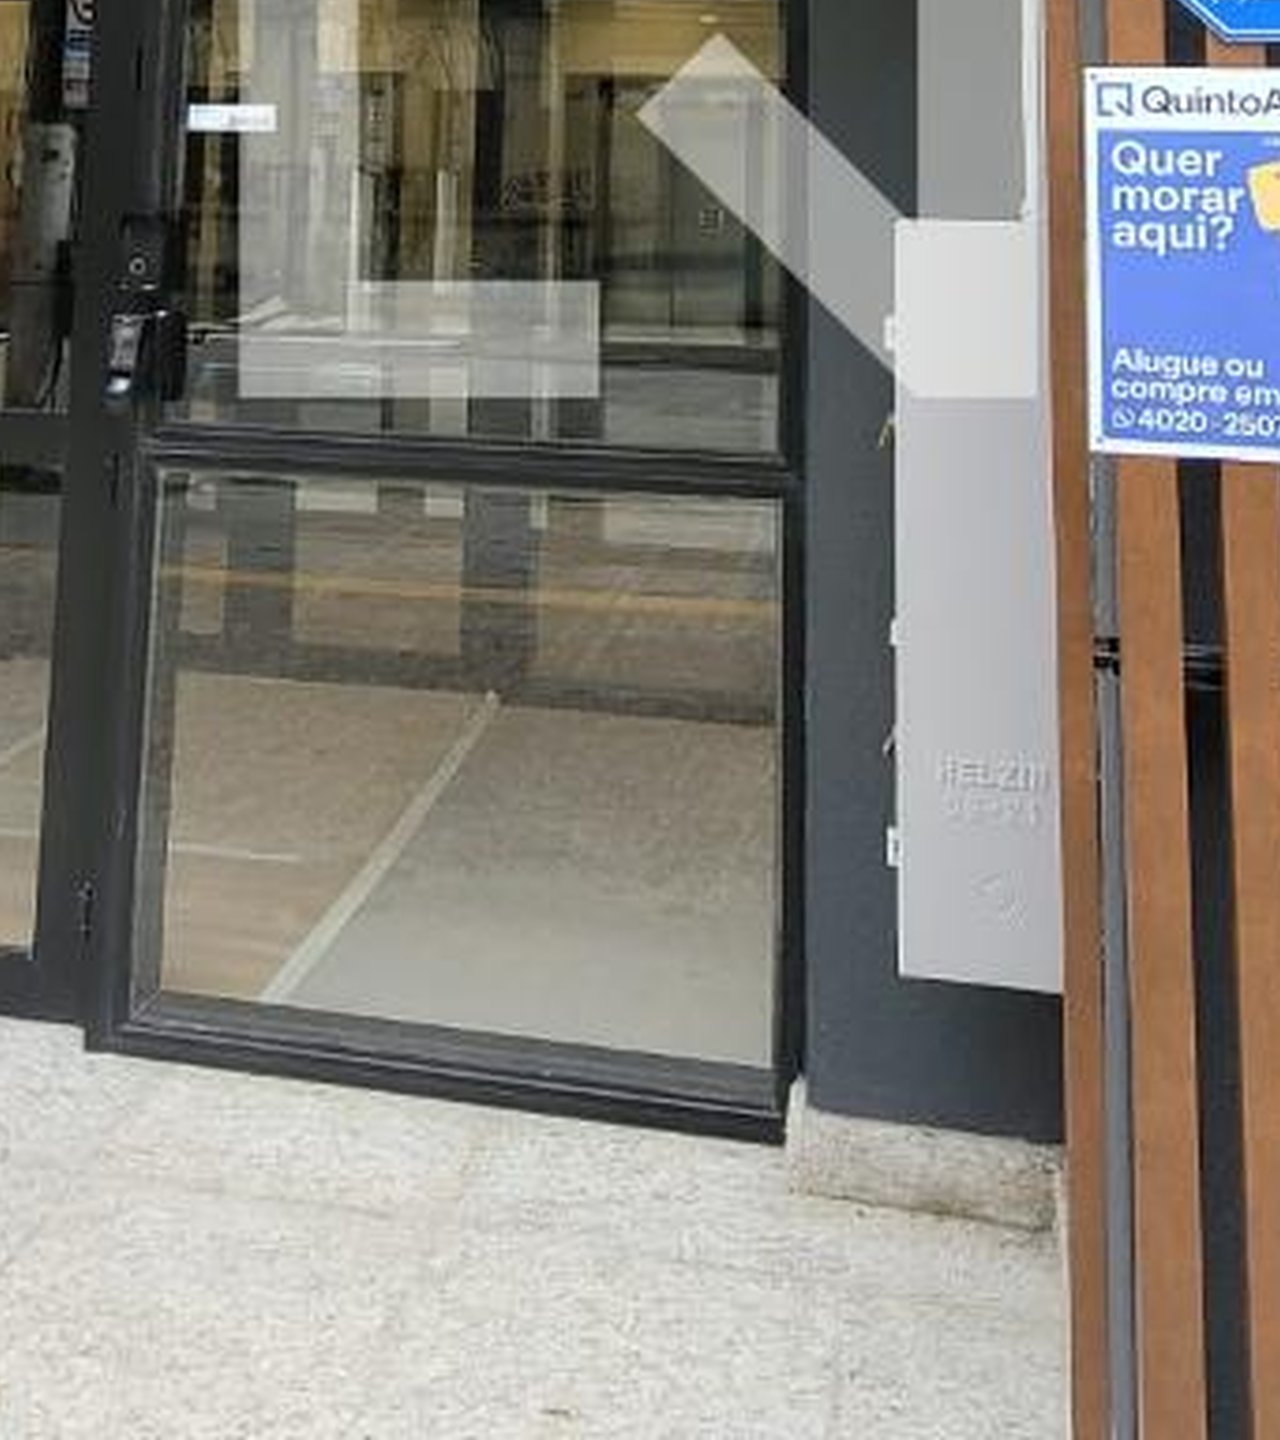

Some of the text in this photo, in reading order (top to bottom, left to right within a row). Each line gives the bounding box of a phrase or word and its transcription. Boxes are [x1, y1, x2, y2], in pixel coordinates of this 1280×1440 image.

[1112, 140, 1222, 177] Quer
[1112, 184, 1245, 213] morar
[1112, 214, 1233, 256] aqui?
[1112, 348, 1264, 379] Alugue ou
[1111, 378, 1227, 405] compre
